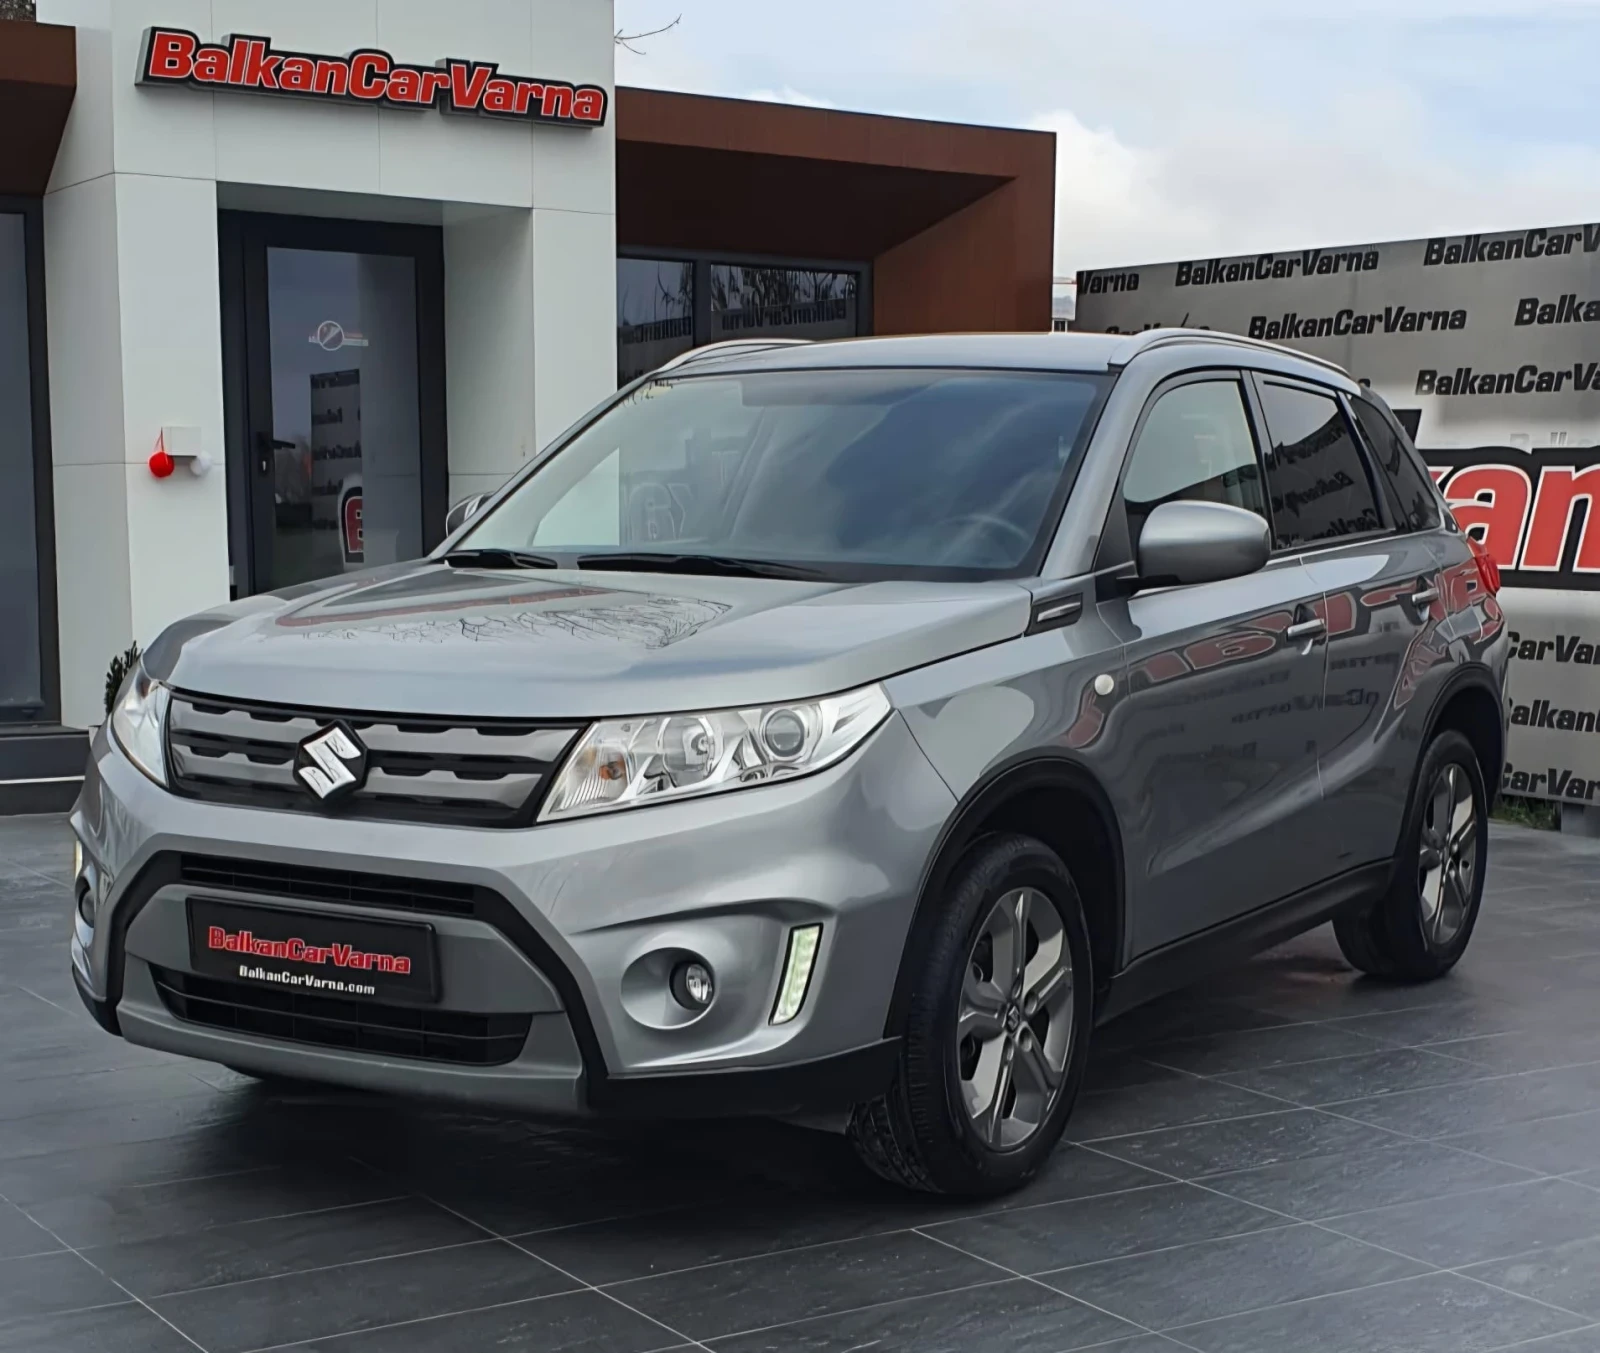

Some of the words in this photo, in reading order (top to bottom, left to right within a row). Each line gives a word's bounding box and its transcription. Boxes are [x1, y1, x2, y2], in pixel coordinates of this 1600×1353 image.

[149, 31, 604, 120] BalkanCarVarna
[1175, 249, 1379, 287] BalkanCarVarna
[1248, 306, 1467, 339] BalkanCarVarna
[1514, 294, 1600, 326] Balka
[209, 926, 411, 974] BalkanCarVarna
[239, 965, 375, 995] BalkanCarVarna.com
